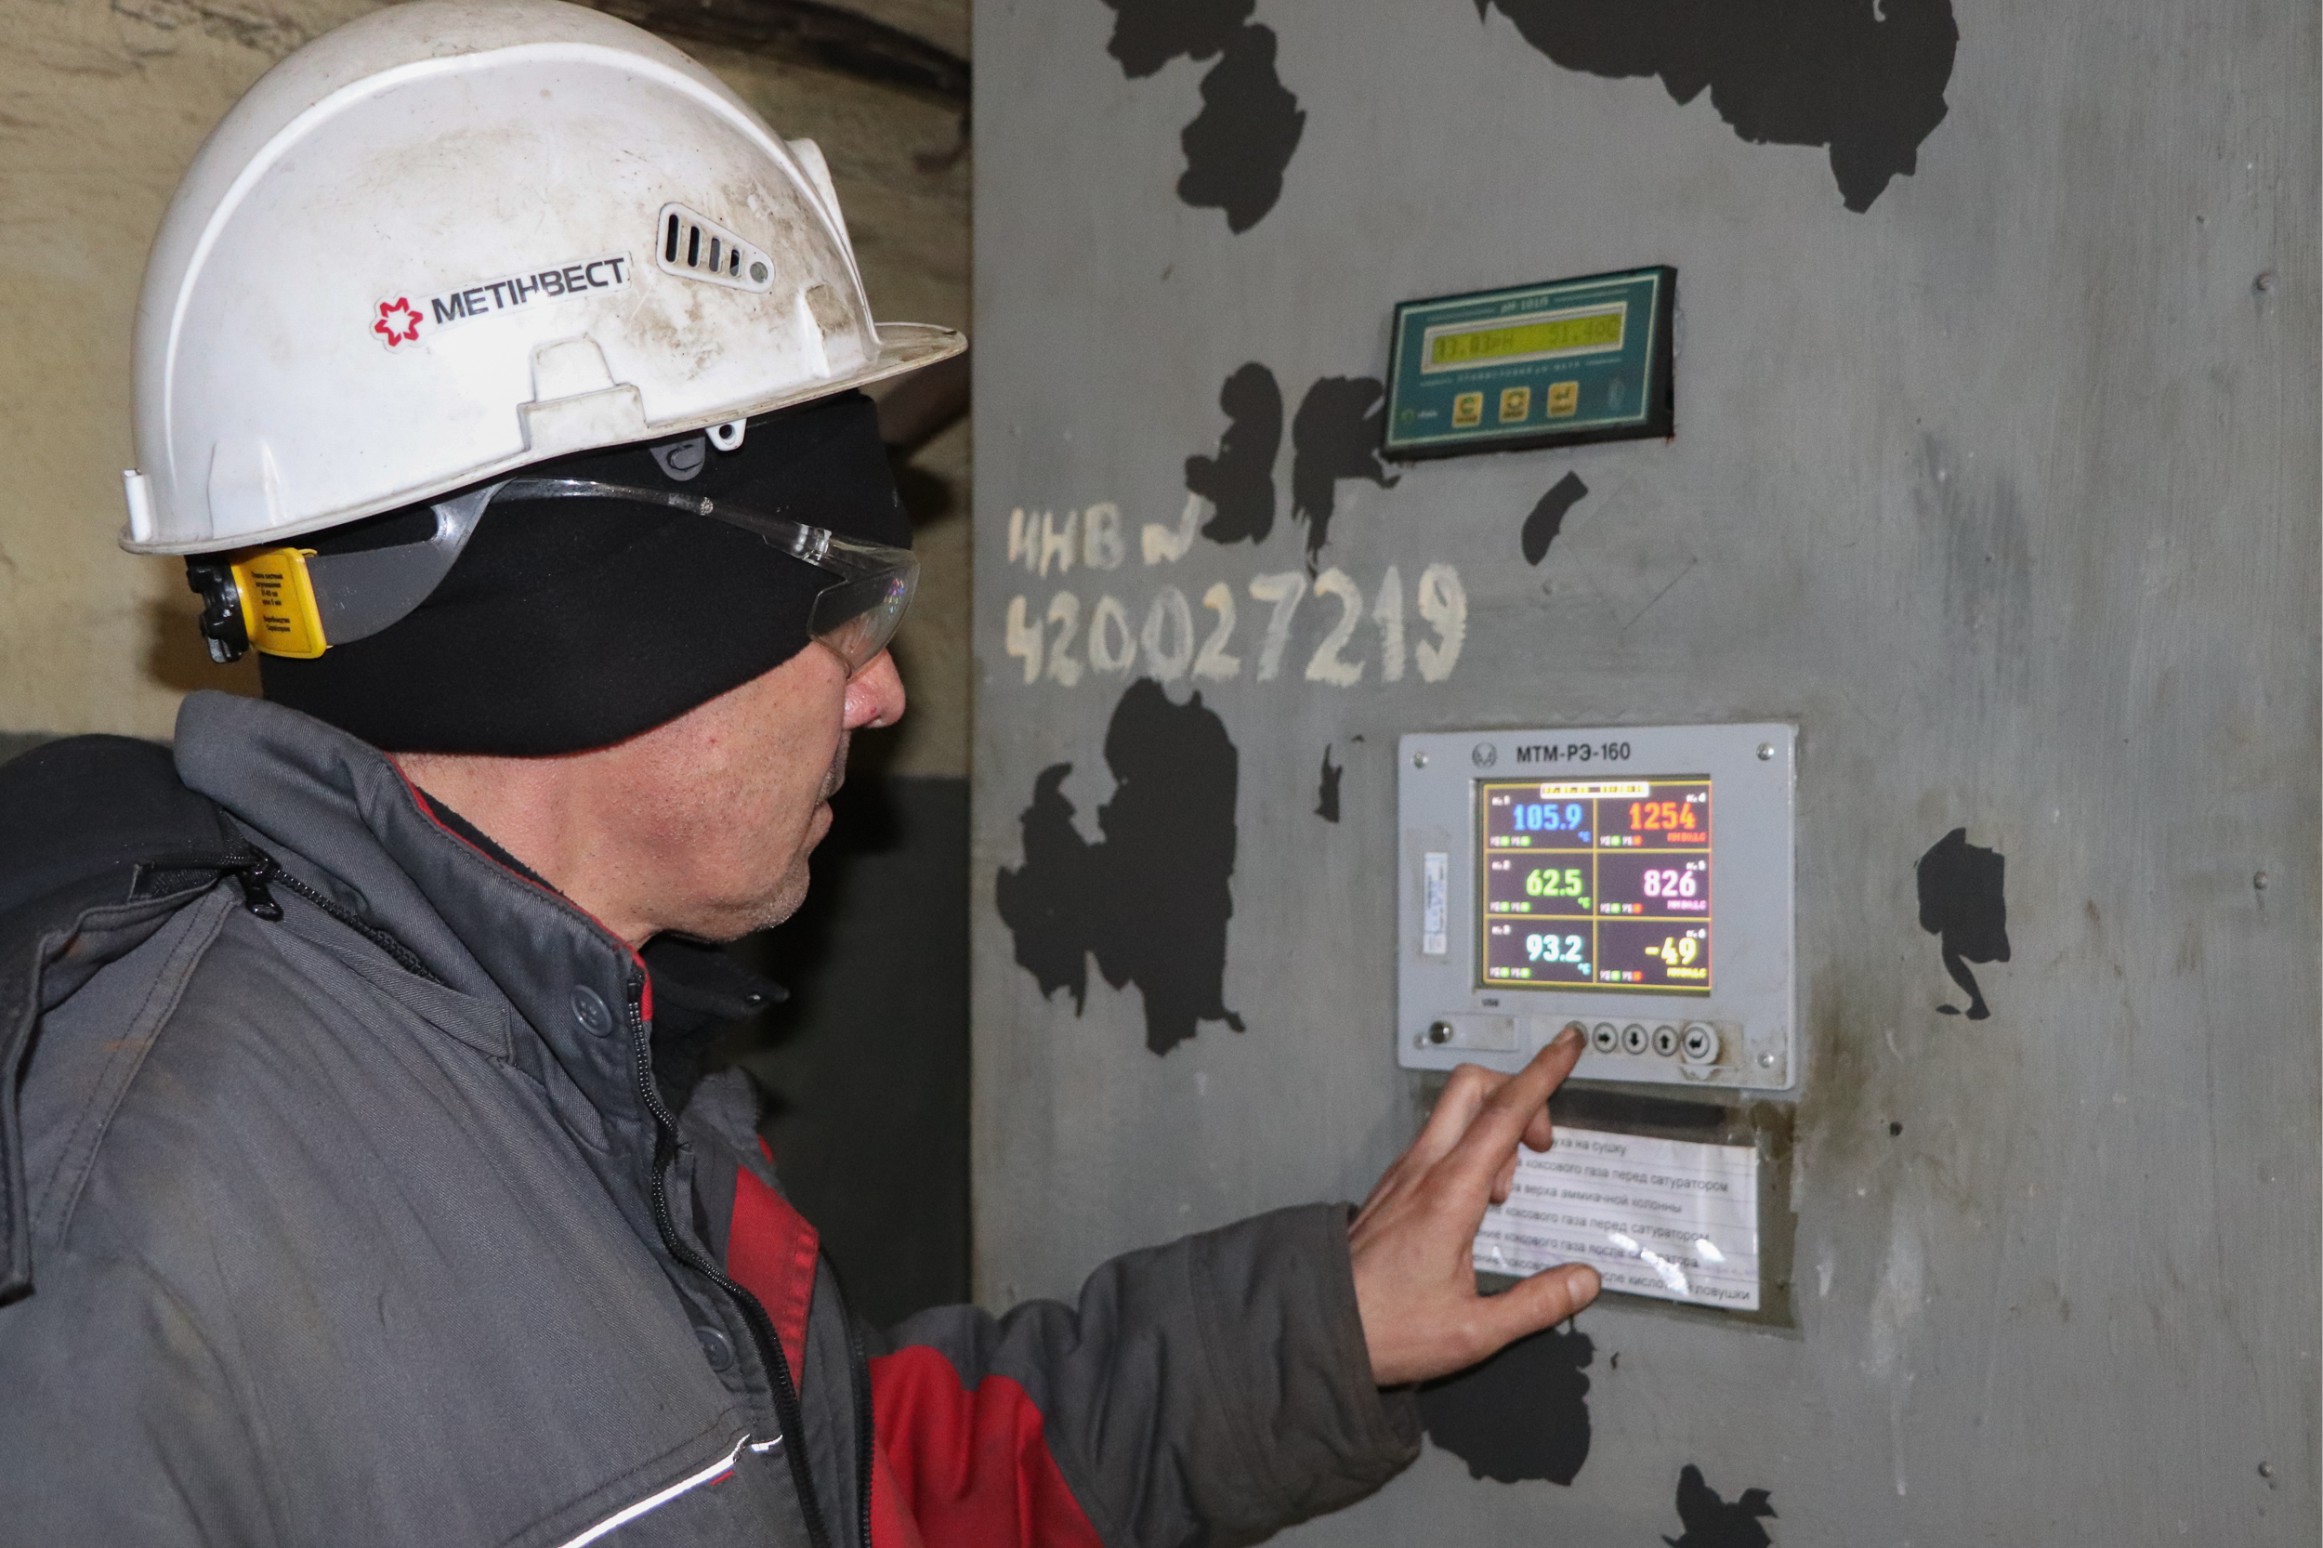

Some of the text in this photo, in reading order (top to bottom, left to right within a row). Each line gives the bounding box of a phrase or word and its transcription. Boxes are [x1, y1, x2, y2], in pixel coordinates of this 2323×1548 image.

[430, 257, 625, 325] МЕТІНВЕСТ
[1006, 564, 1468, 688] 420027219
[1517, 742, 1631, 762] МТМ-РЭ-160
[1513, 803, 1582, 831] 105.9
[1629, 802, 1696, 830] 1254
[1526, 869, 1582, 896] 62.5
[1643, 869, 1696, 897] 826
[1526, 934, 1583, 962] 93.2
[1645, 937, 1697, 965] -49
[1526, 1159, 1582, 1174] коксового
[1584, 1165, 1609, 1178] газа
[1612, 1169, 1648, 1184] перед
[1650, 1174, 1728, 1192] сатуратором
[1561, 1188, 1629, 1206] аммиачной
[1632, 1198, 1682, 1213] колонны
[1506, 1207, 1559, 1223] коксового
[1561, 1215, 1587, 1227] газа
[1589, 1218, 1627, 1233] перед
[1504, 1233, 1558, 1248] коксового
[1560, 1241, 1585, 1253] газа
[1695, 1285, 1750, 1301] ловушки
